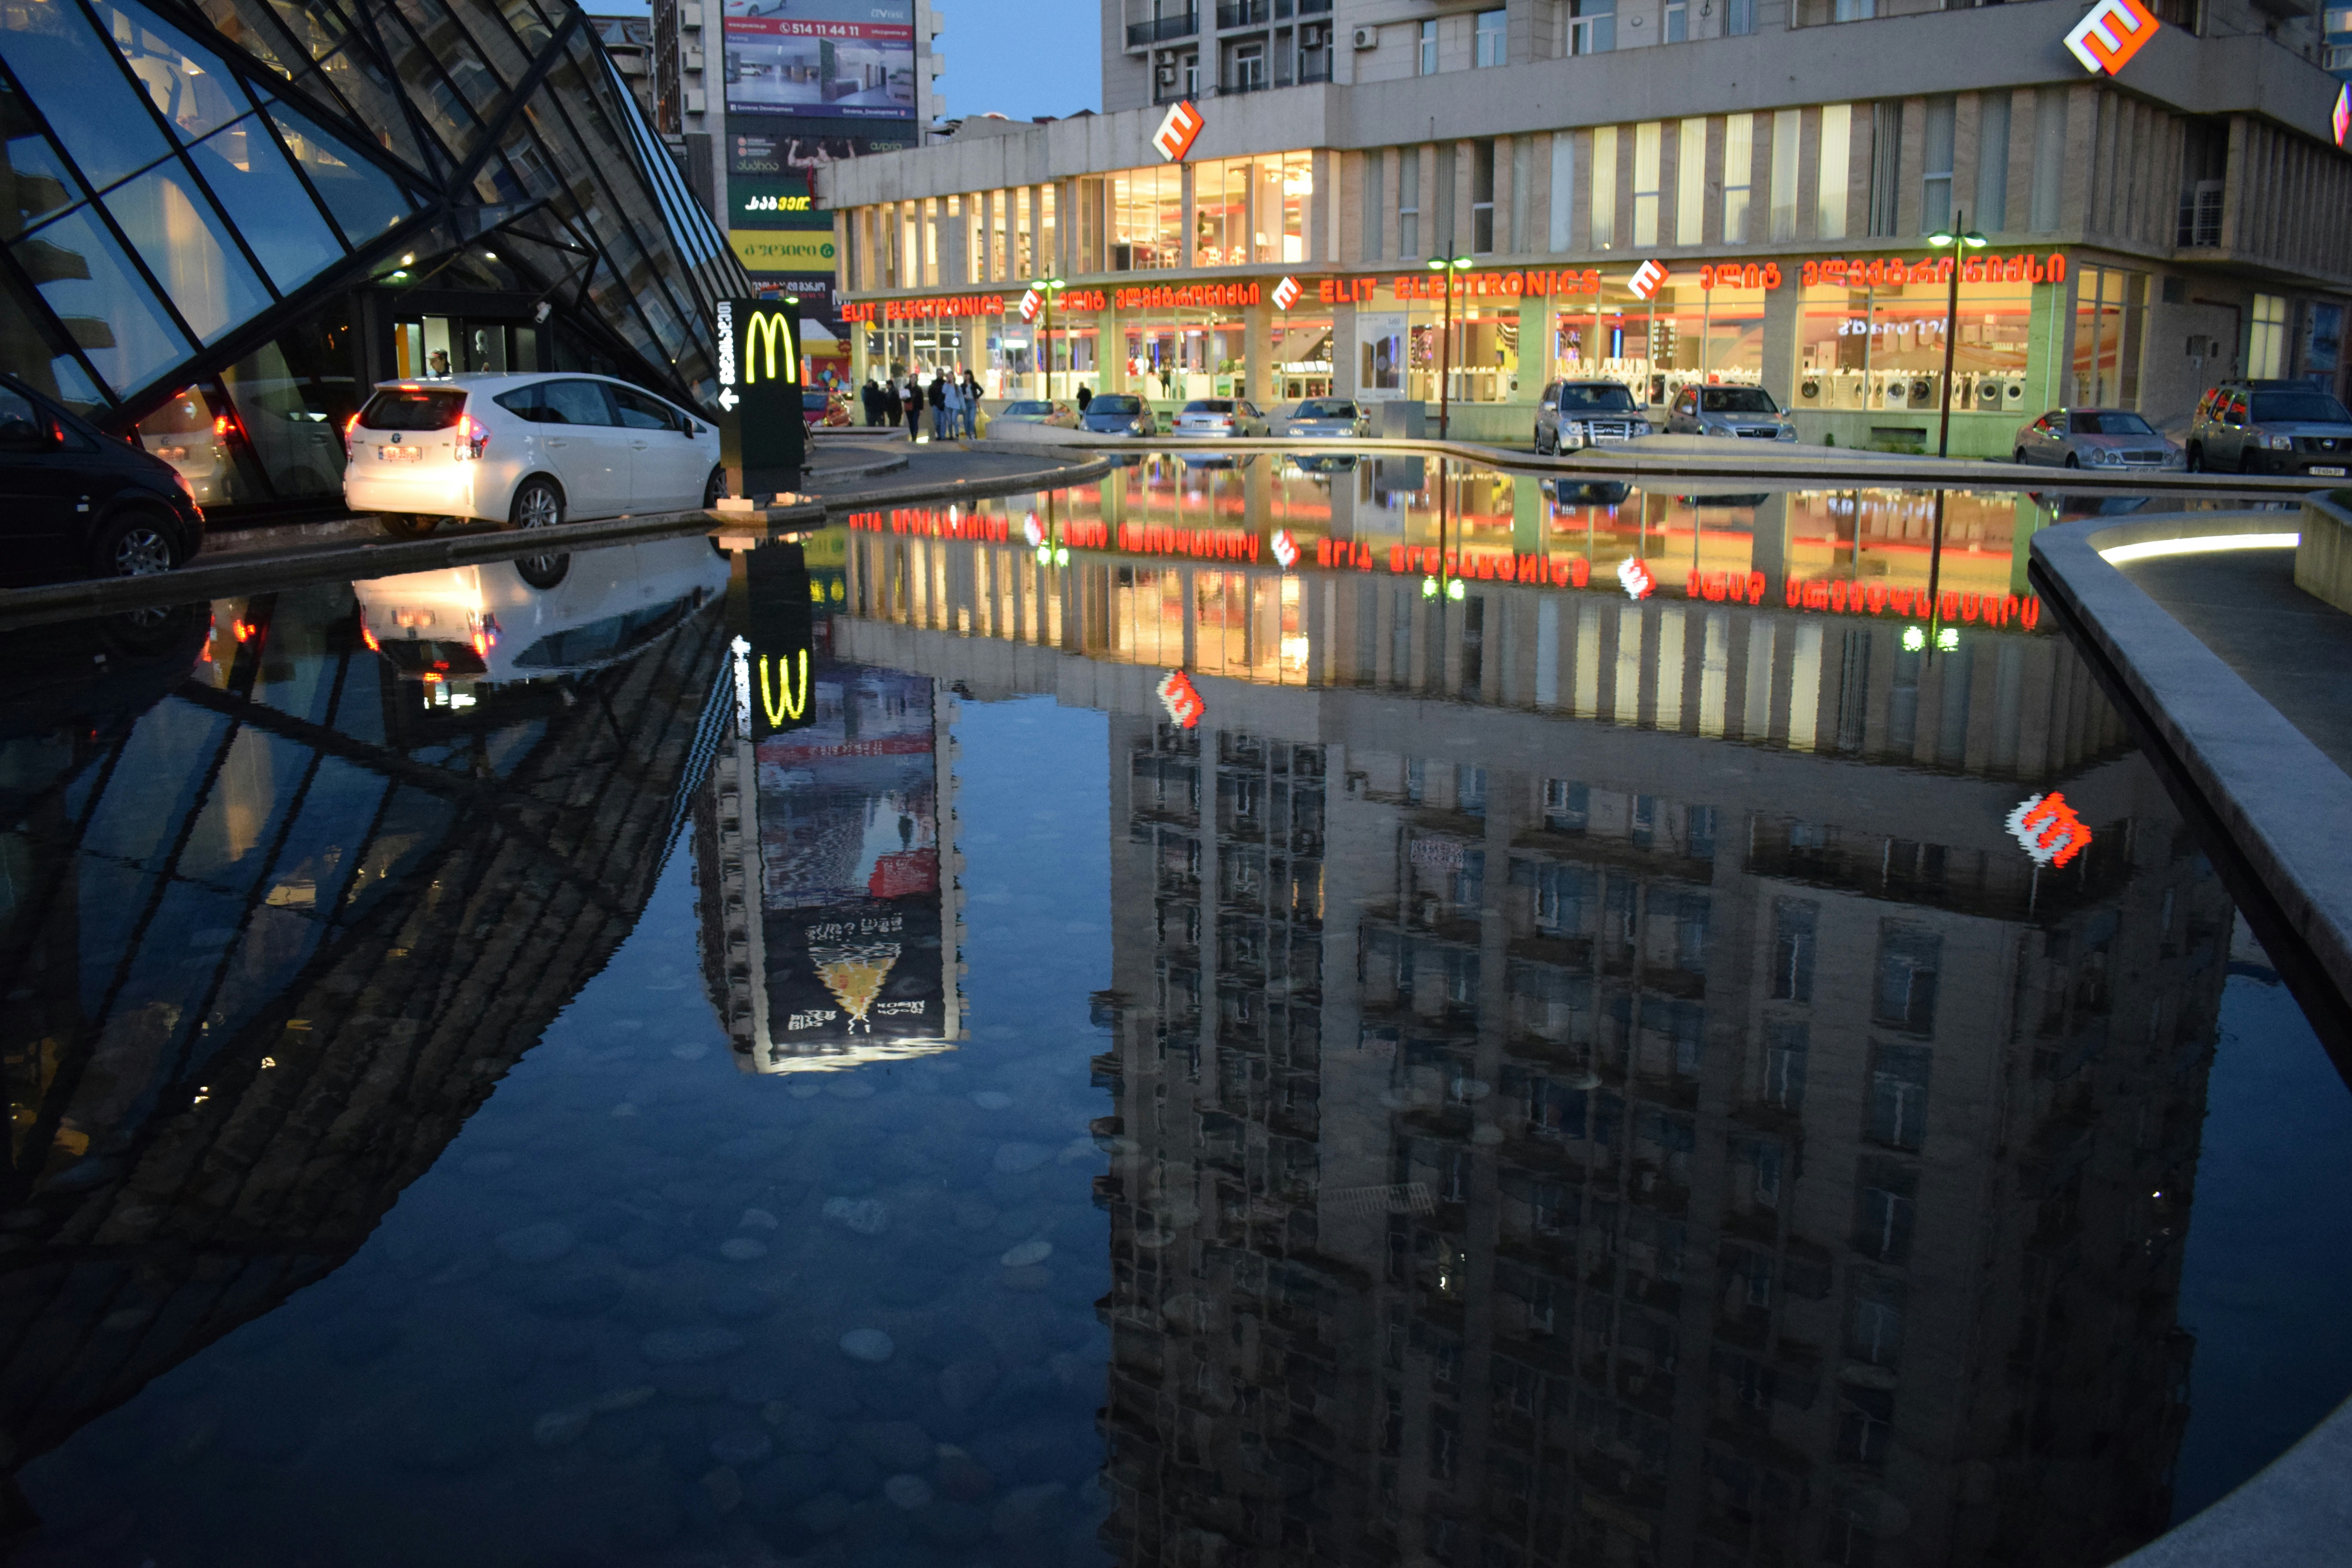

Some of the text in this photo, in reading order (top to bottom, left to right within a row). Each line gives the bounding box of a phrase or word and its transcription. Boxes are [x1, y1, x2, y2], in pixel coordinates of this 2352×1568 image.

[792, 23, 859, 36] 514 11 44 11
[1320, 269, 1600, 303] ELIT ELECTRONICS
[1700, 263, 1781, 290] ელიტ
[842, 296, 1004, 321] ELIT ELECTRONICS
[1060, 283, 1260, 312] ელიტ ელექტრონიქსი
